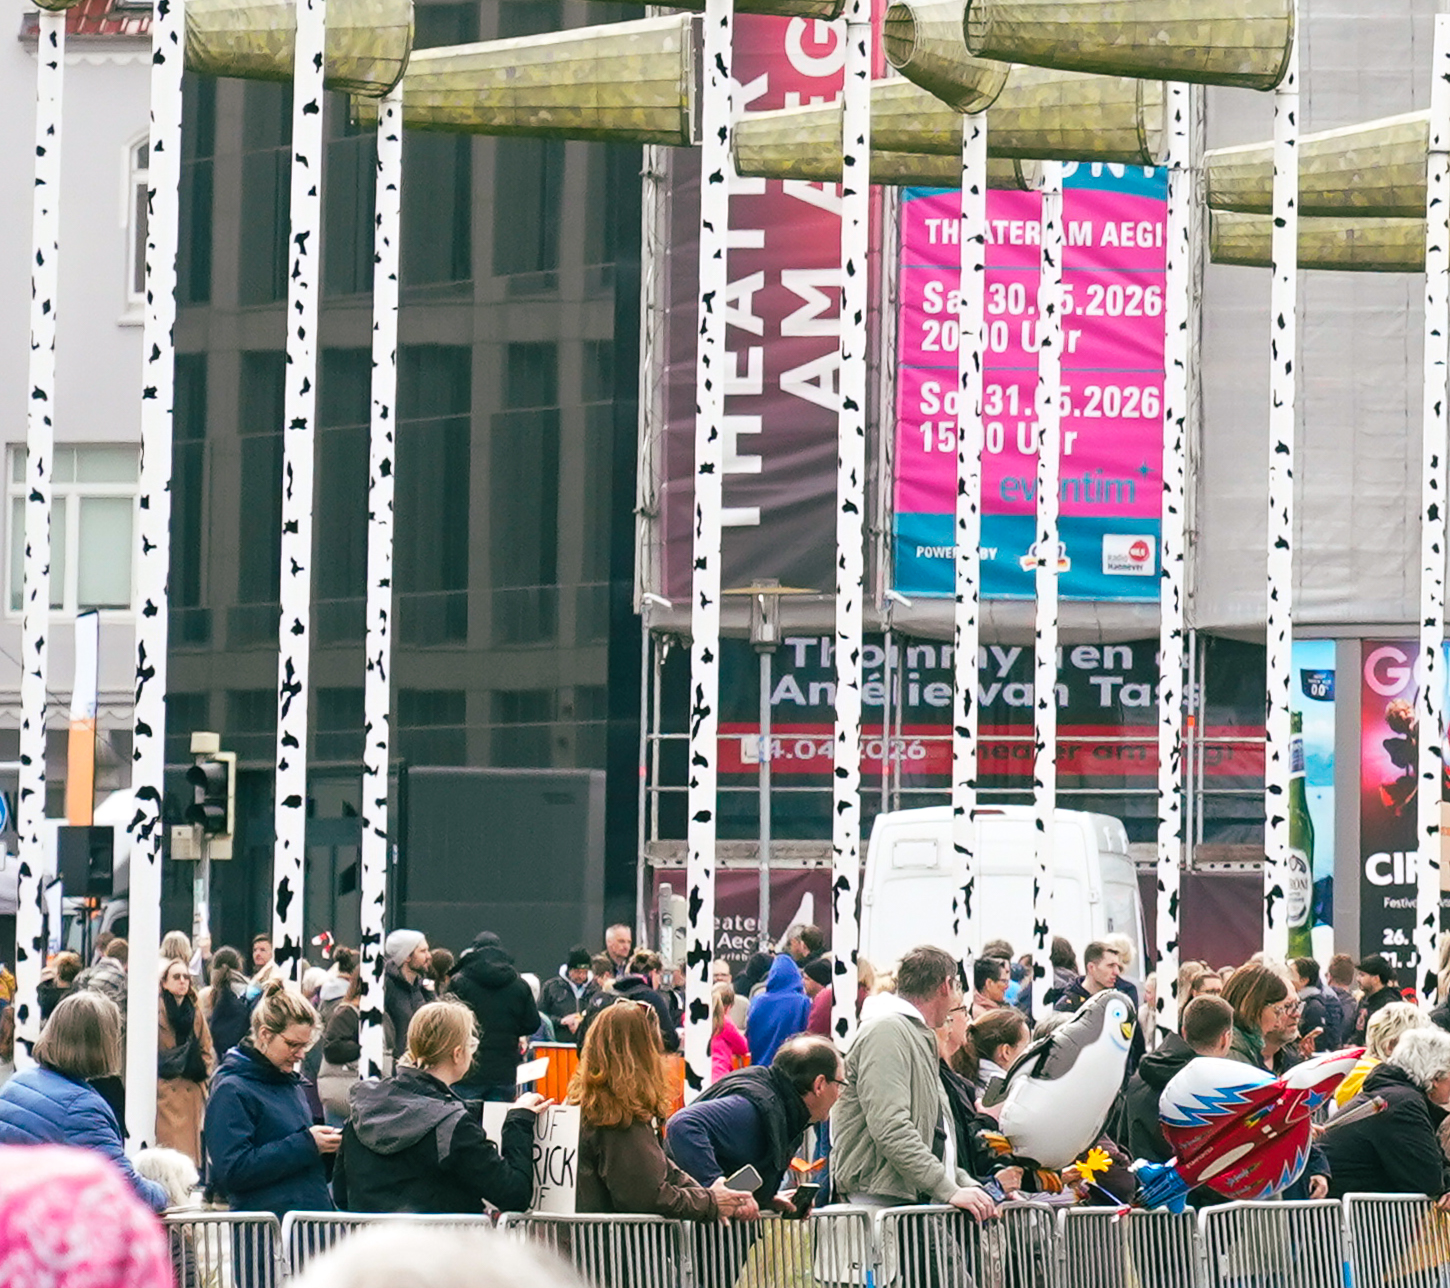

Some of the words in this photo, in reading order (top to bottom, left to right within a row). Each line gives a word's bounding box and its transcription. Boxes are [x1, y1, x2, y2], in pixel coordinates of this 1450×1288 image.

[925, 219, 1042, 246] THATER
[1101, 221, 1163, 248] AEGI
[1000, 469, 1136, 504] evntim
